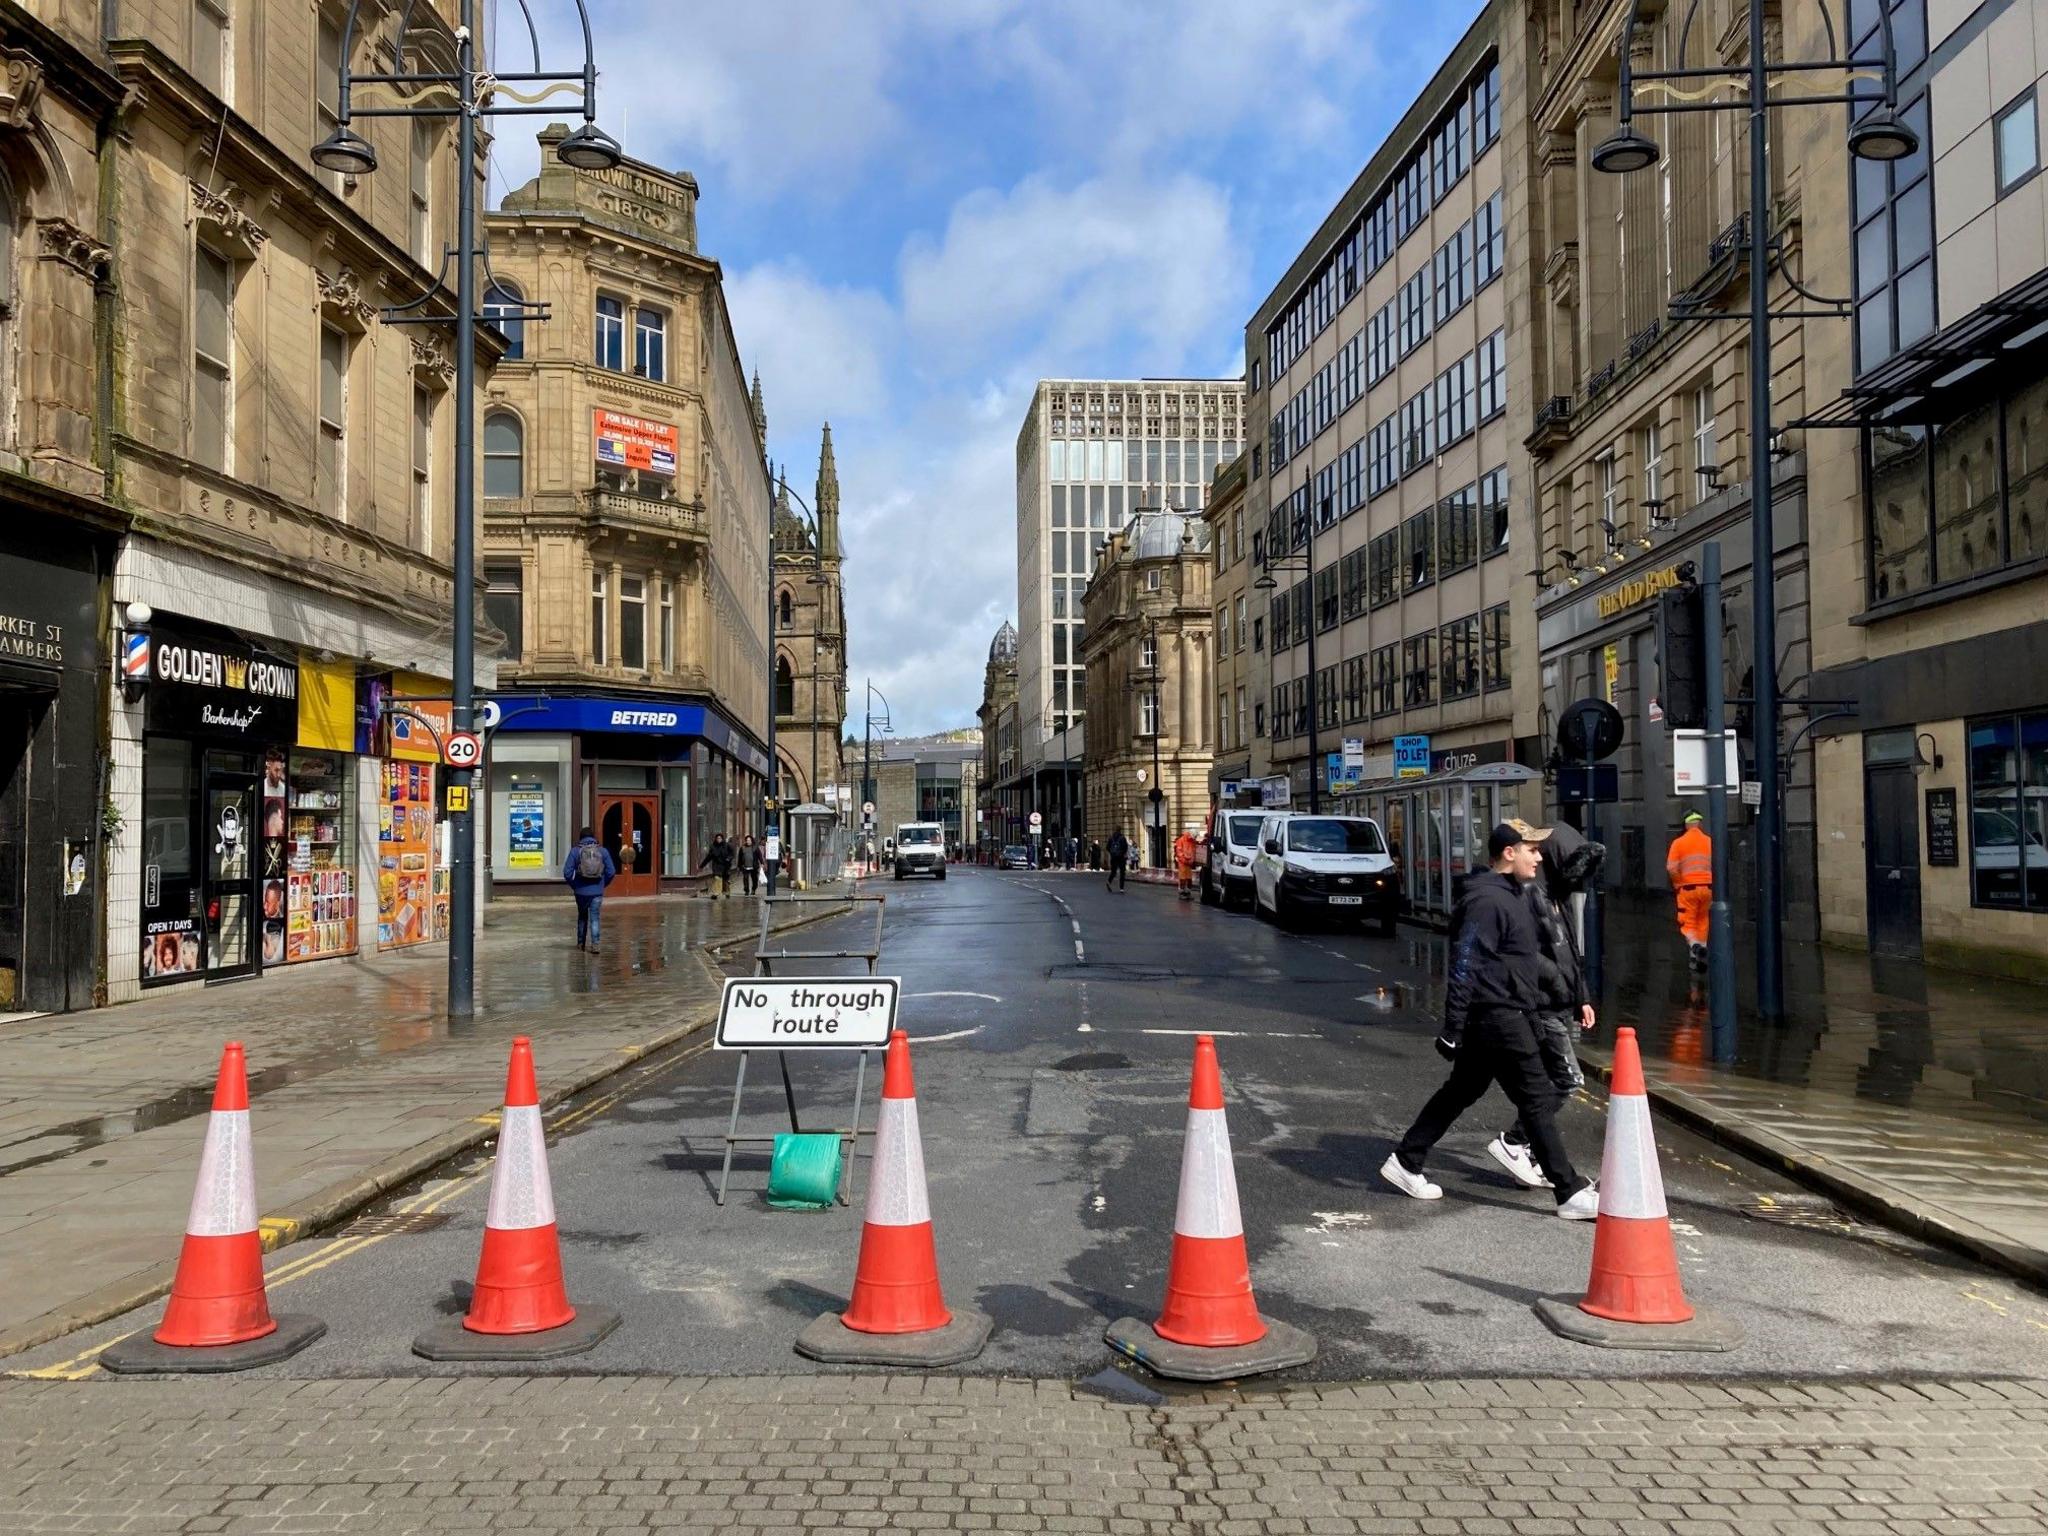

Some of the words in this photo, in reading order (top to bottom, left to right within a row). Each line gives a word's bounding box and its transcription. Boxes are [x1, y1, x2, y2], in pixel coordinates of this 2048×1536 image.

[614, 197, 652, 222] 1870
[600, 421, 632, 433] Extensive
[633, 429, 652, 440] Upper
[654, 433, 673, 444] Floors
[605, 413, 621, 425] FOR
[621, 417, 640, 429] SALE
[645, 423, 655, 431] TO
[656, 425, 668, 434] LET
[1598, 593, 1620, 618] THE
[1620, 581, 1645, 609] OLD
[46, 624, 63, 642] ST
[157, 644, 222, 688] GOLDEN
[248, 661, 295, 699] CROWN
[202, 704, 251, 732] Barbershop
[611, 710, 677, 727] BETFRED
[450, 743, 475, 757] 20
[1401, 738, 1422, 747] SHOP
[1396, 749, 1408, 761] TO
[1411, 748, 1428, 761] LET
[1330, 766, 1341, 779] TO
[450, 788, 466, 806] H
[147, 922, 168, 933] OPEN
[169, 921, 173, 931] 7
[174, 920, 192, 930] DAYS
[734, 989, 768, 1008] No
[790, 989, 885, 1011] through
[772, 1014, 839, 1034] route
